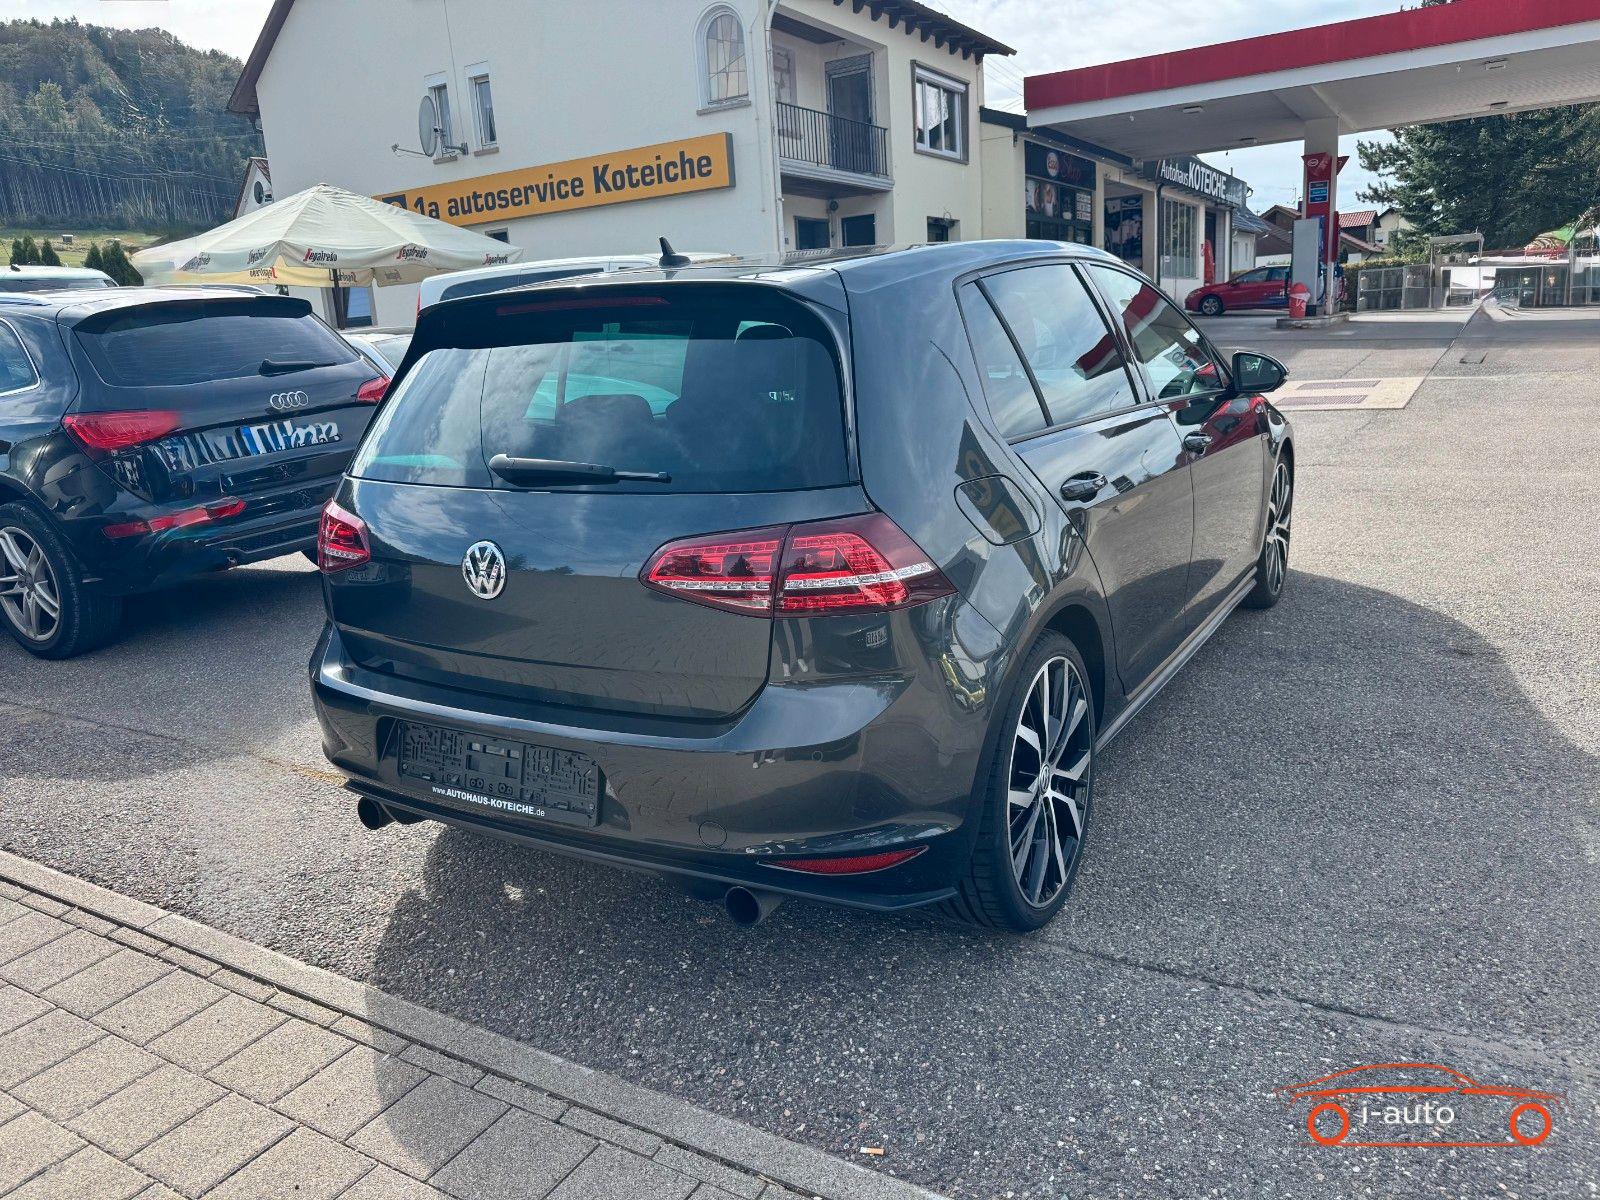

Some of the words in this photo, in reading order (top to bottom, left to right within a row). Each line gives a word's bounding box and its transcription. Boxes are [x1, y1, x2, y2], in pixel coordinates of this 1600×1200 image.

[414, 196, 440, 219] 1a
[447, 173, 584, 217] autoservice
[593, 150, 713, 194] Koteiche
[1160, 159, 1188, 186] Autohaus
[1188, 161, 1227, 199] KOTEICHE
[396, 245, 428, 260] Segafredo
[431, 785, 546, 817] www.AUTOHAUS-KOTEICHE.de
